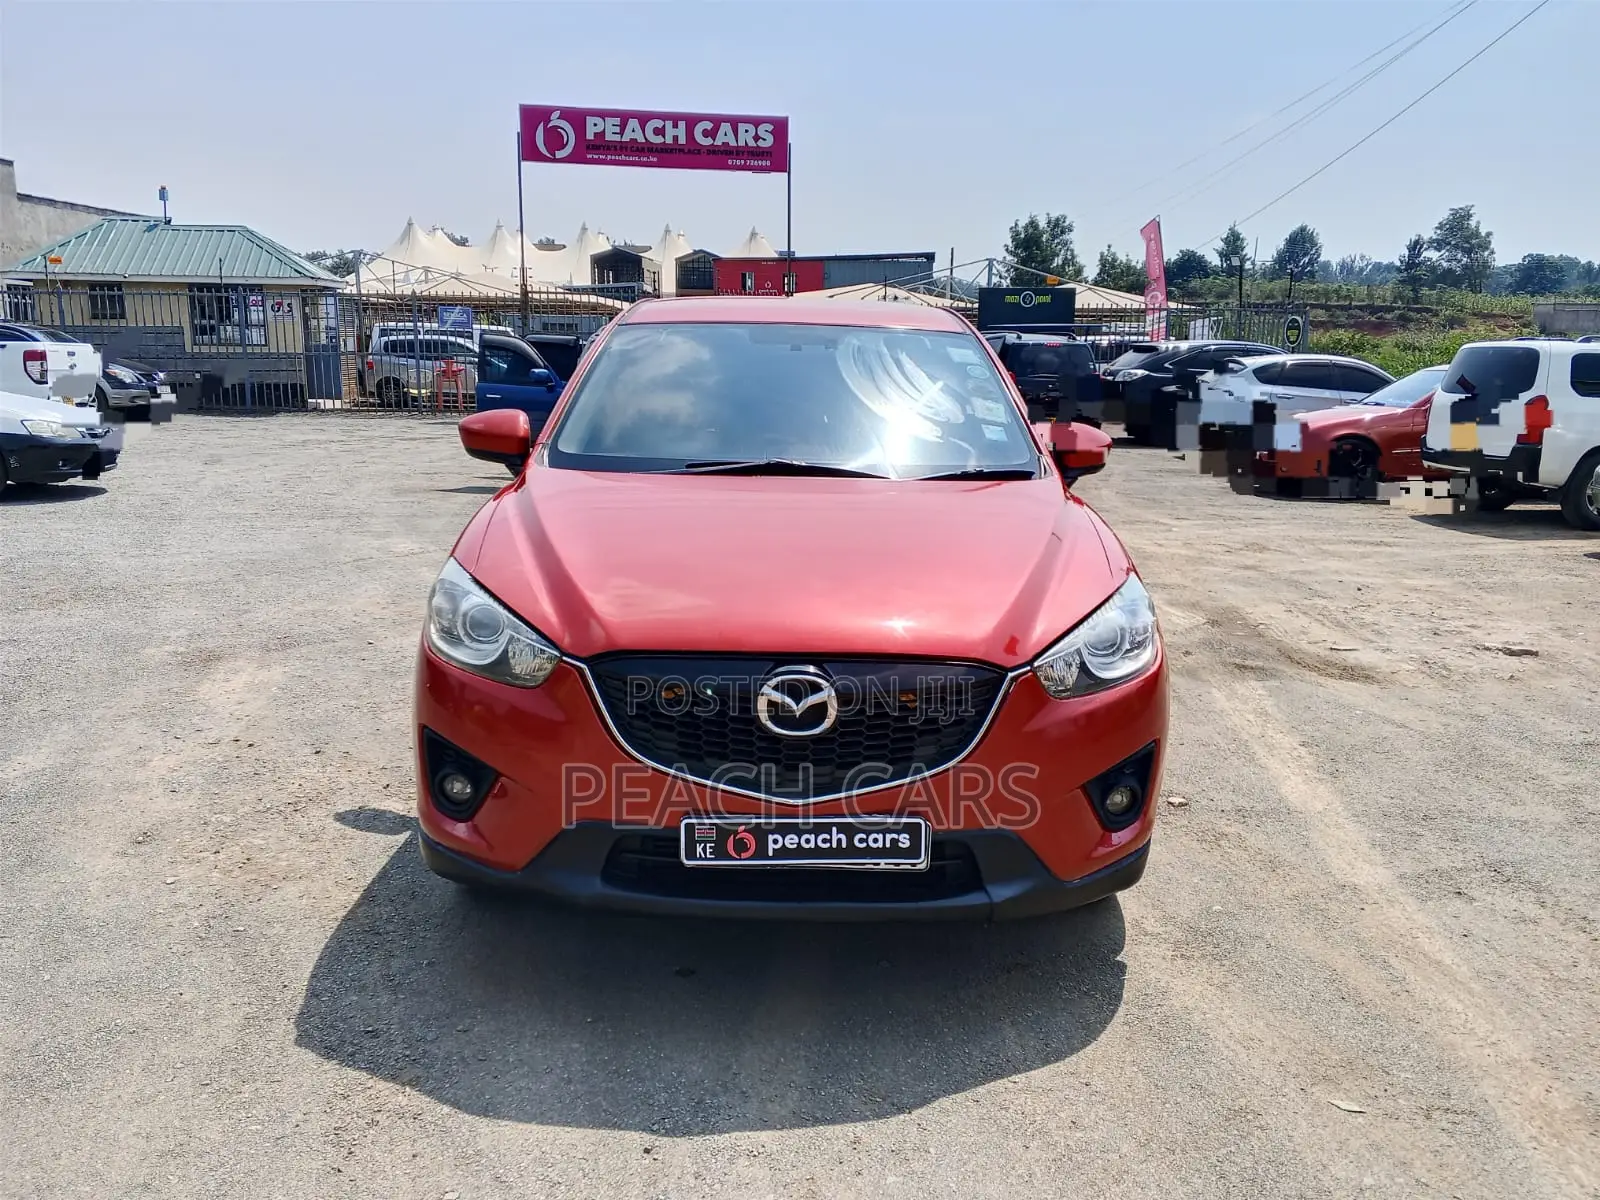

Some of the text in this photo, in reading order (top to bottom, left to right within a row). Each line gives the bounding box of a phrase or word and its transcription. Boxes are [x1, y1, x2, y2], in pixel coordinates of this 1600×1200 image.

[585, 115, 775, 147] PEACH CARS
[696, 826, 911, 858] KE peach cars
